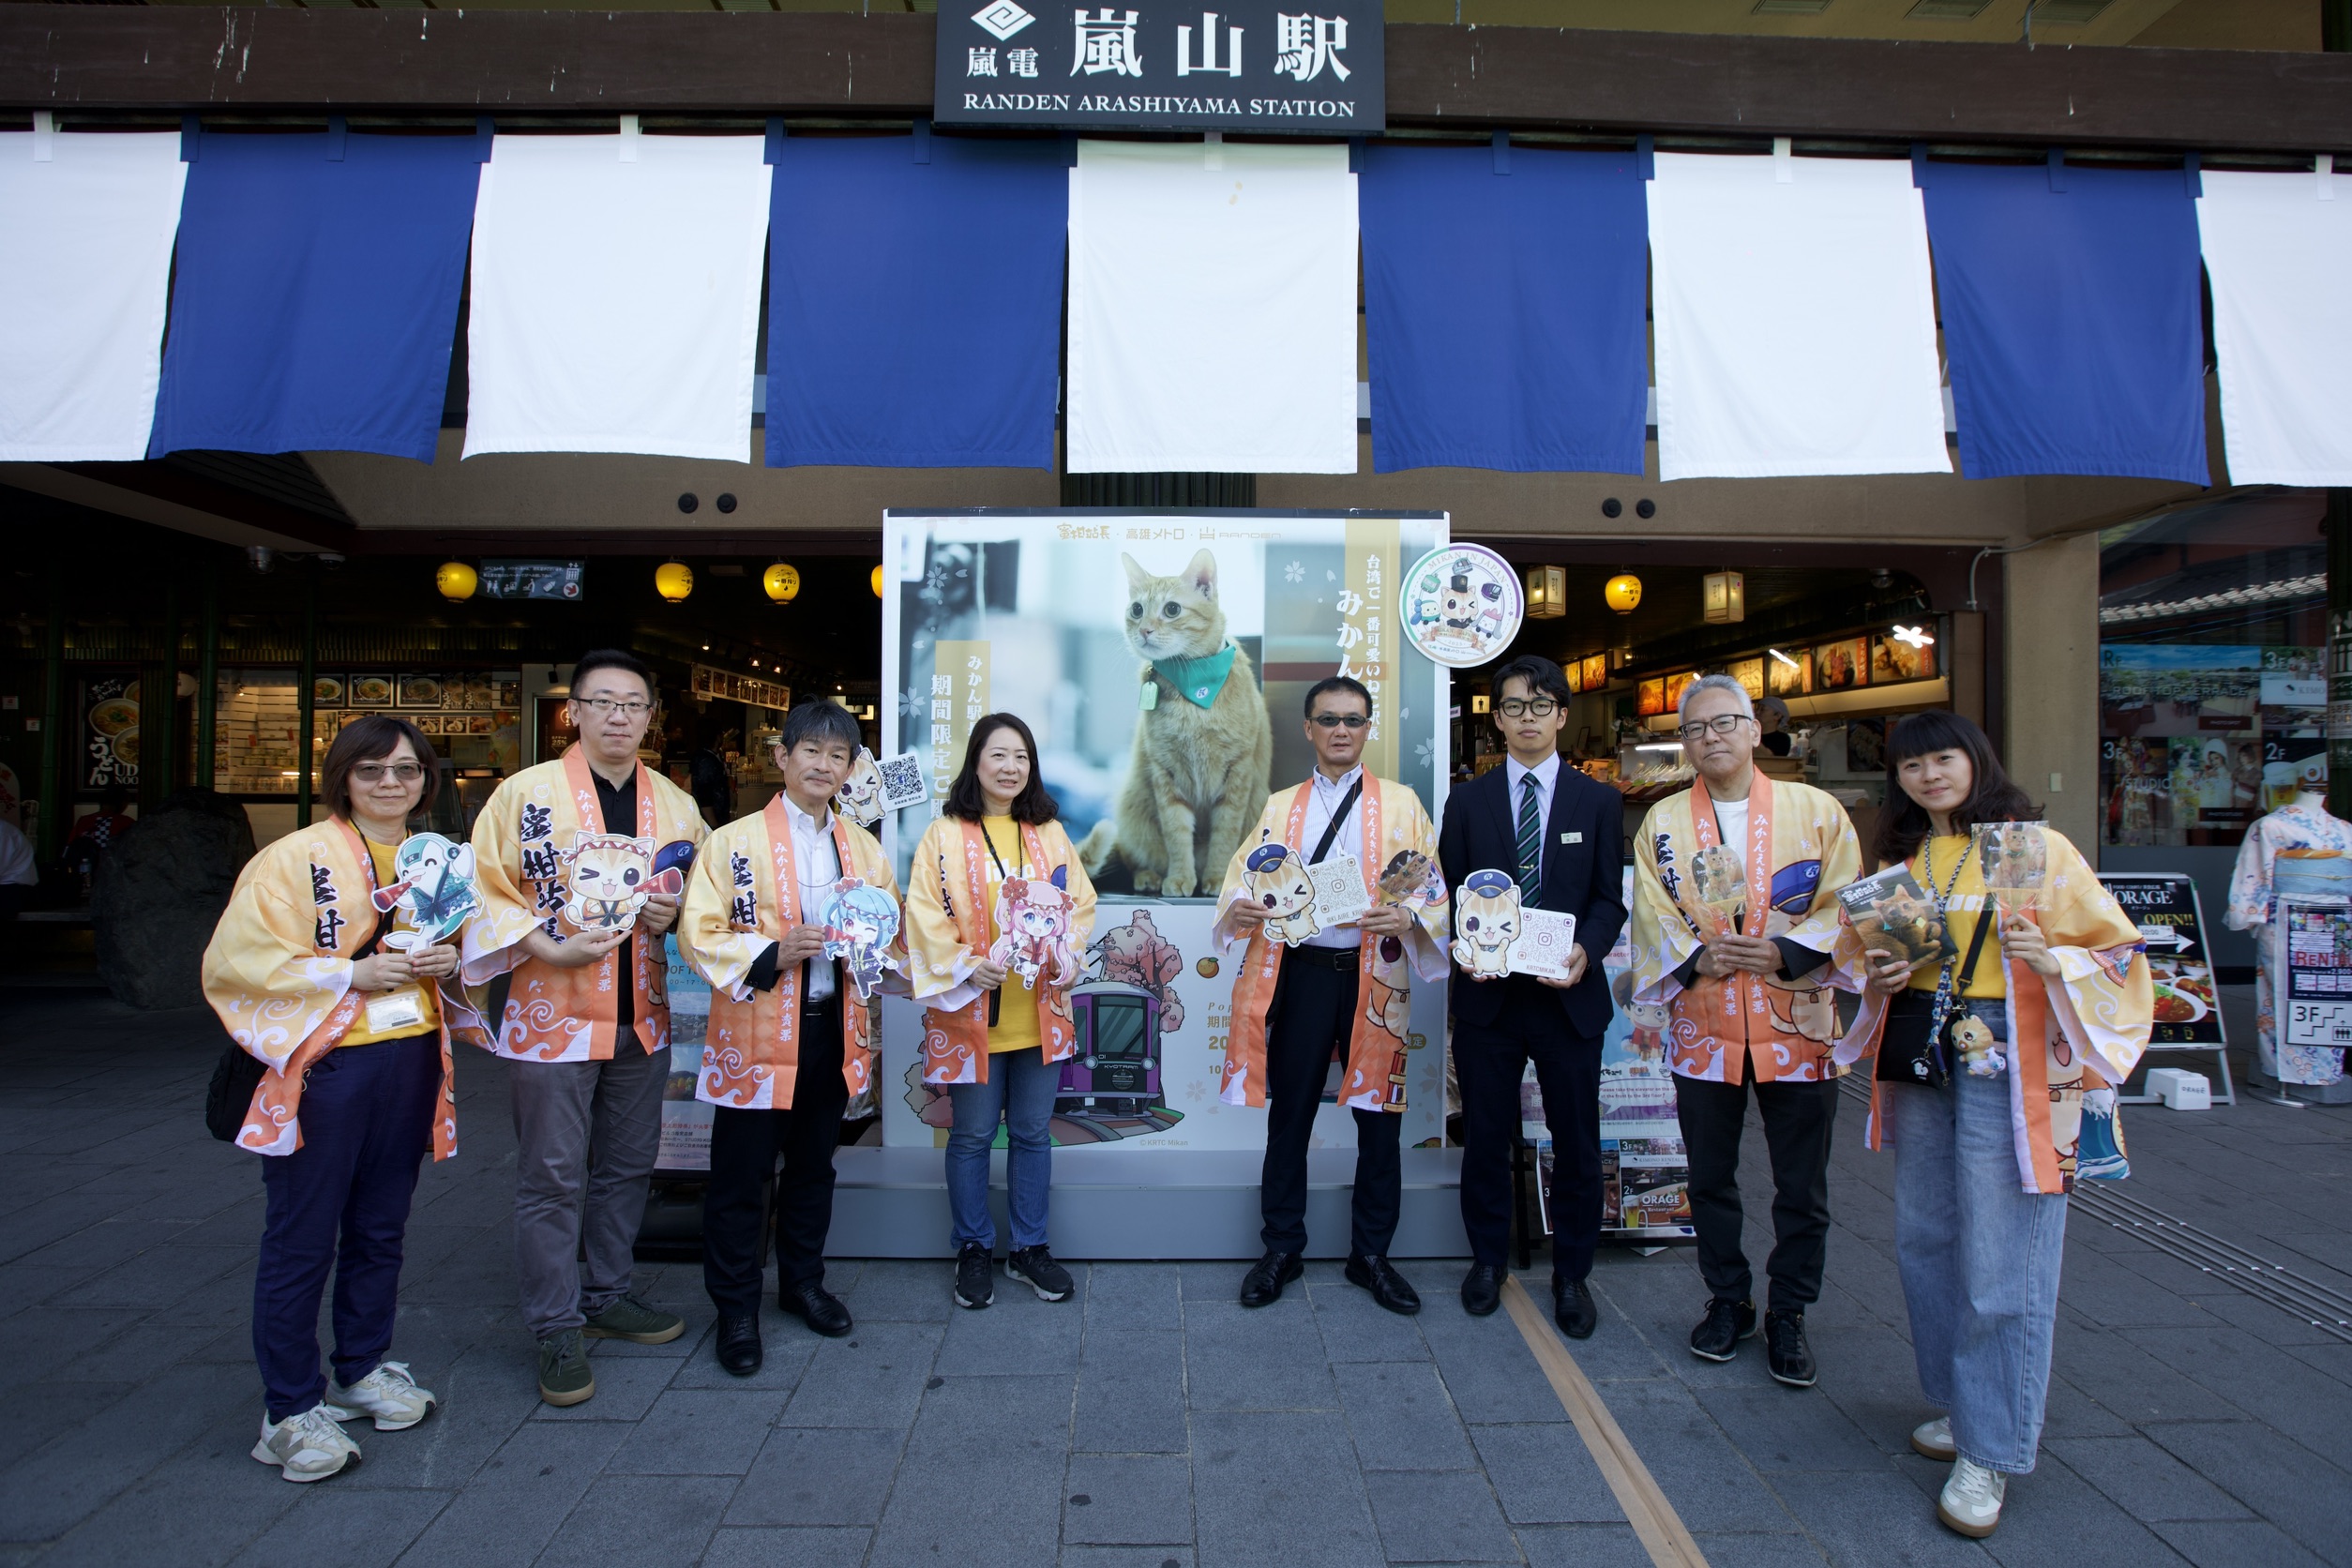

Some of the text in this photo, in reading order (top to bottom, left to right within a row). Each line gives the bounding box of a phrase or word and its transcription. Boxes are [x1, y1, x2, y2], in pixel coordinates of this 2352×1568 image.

[1069, 8, 1351, 83] 嵐山駅
[966, 47, 1039, 78] 嵐電
[964, 93, 1355, 117] RANDEN ARASHIYAMA STATION
[1427, 551, 1508, 583] MIKAN IN JAPAN
[2186, 686, 2247, 697] TERRACE
[89, 736, 114, 786] うどん
[2114, 890, 2173, 905] ORAGE
[2144, 913, 2194, 927] OPEN!!
[2294, 1006, 2319, 1022] 3F
[1642, 1195, 1681, 1205] ORAGE
